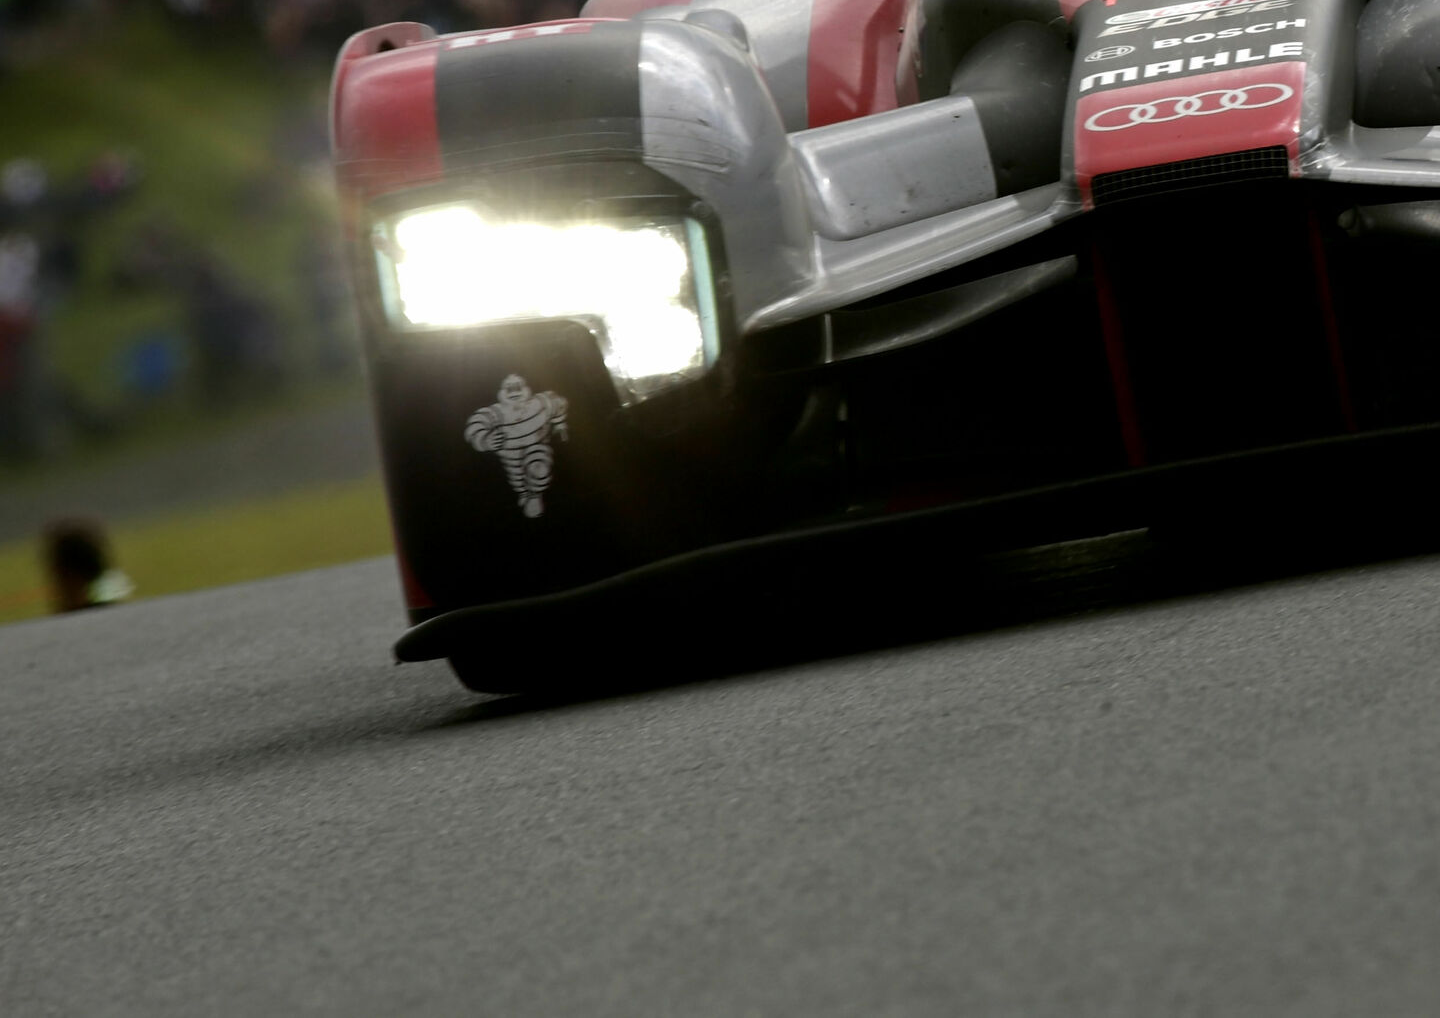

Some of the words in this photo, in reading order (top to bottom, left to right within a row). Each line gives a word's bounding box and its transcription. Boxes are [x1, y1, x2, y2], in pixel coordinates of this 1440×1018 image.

[1096, 0, 1295, 39] EDGE
[1152, 17, 1307, 50] BOSCH
[1079, 41, 1304, 93] MAHLE
